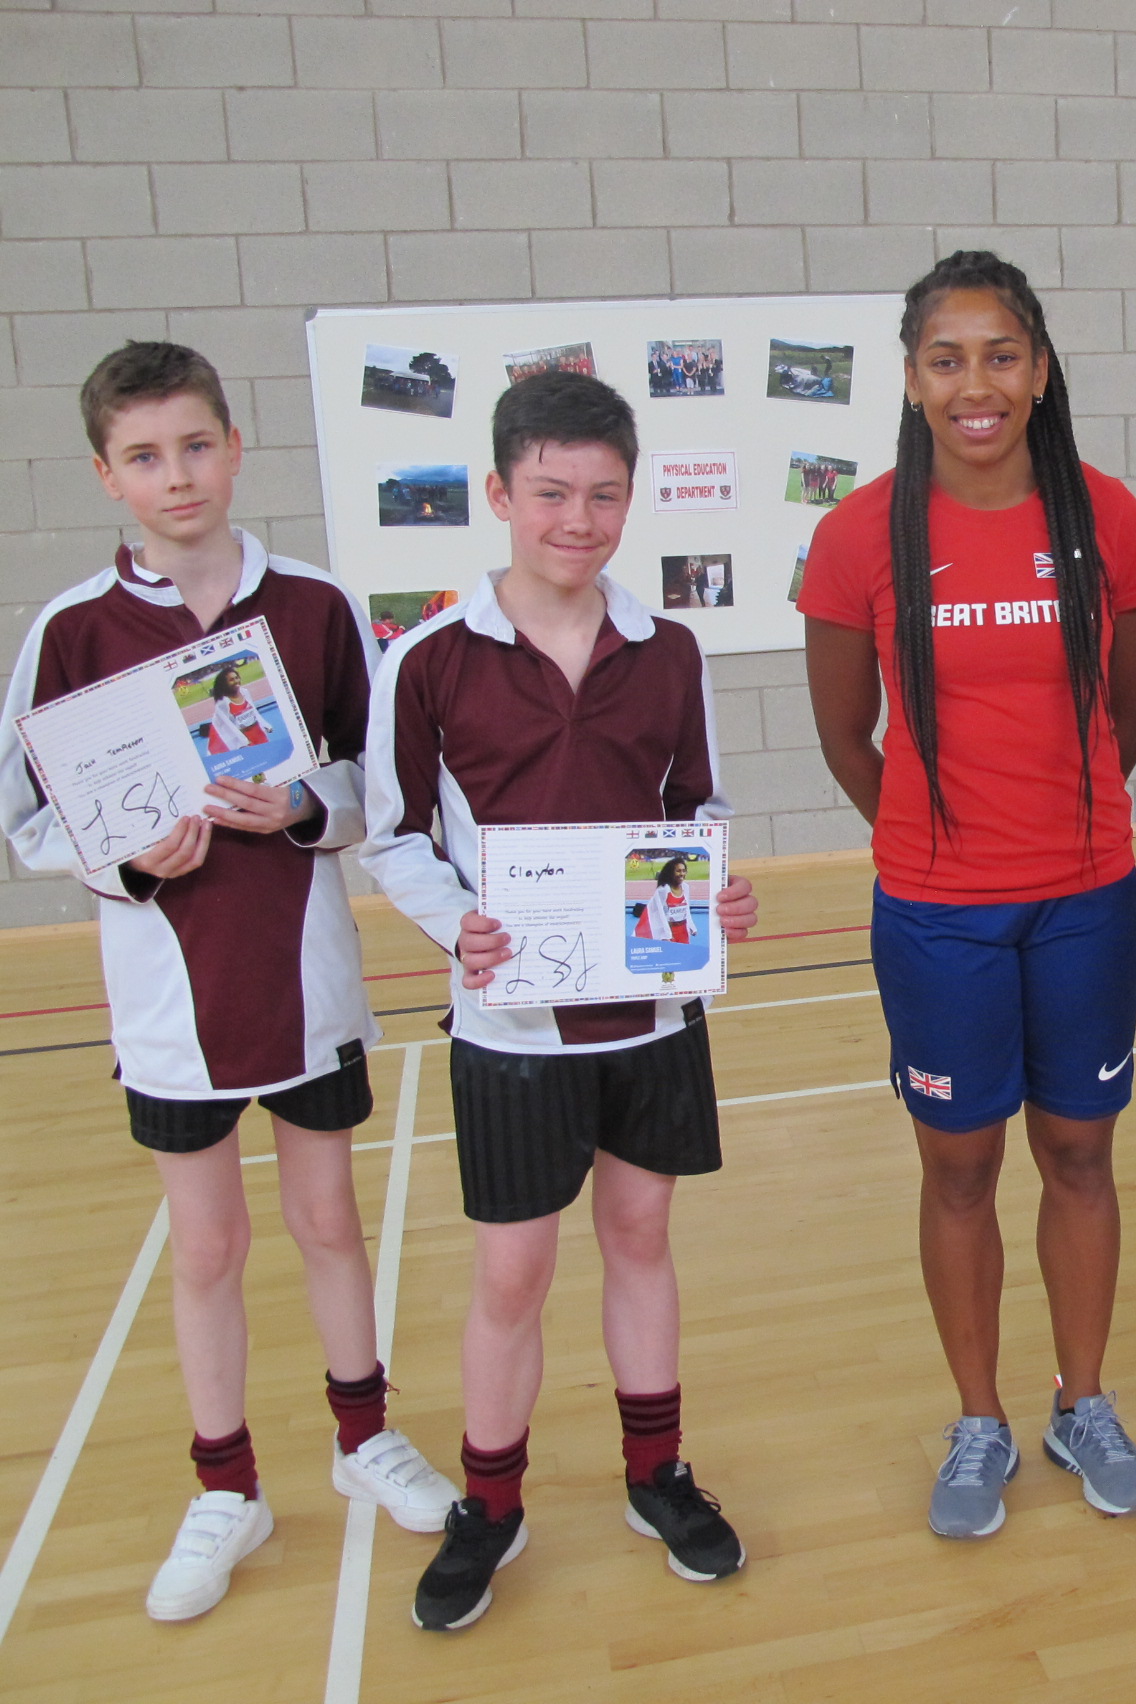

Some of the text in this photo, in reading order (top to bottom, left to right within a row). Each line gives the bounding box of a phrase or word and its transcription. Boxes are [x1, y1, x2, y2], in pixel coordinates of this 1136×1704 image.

[663, 462, 727, 477] PHYSICAL EDUCATION
[676, 485, 716, 499] DEPARTMENT
[931, 603, 987, 627] EAT
[509, 862, 565, 883] Clayton
